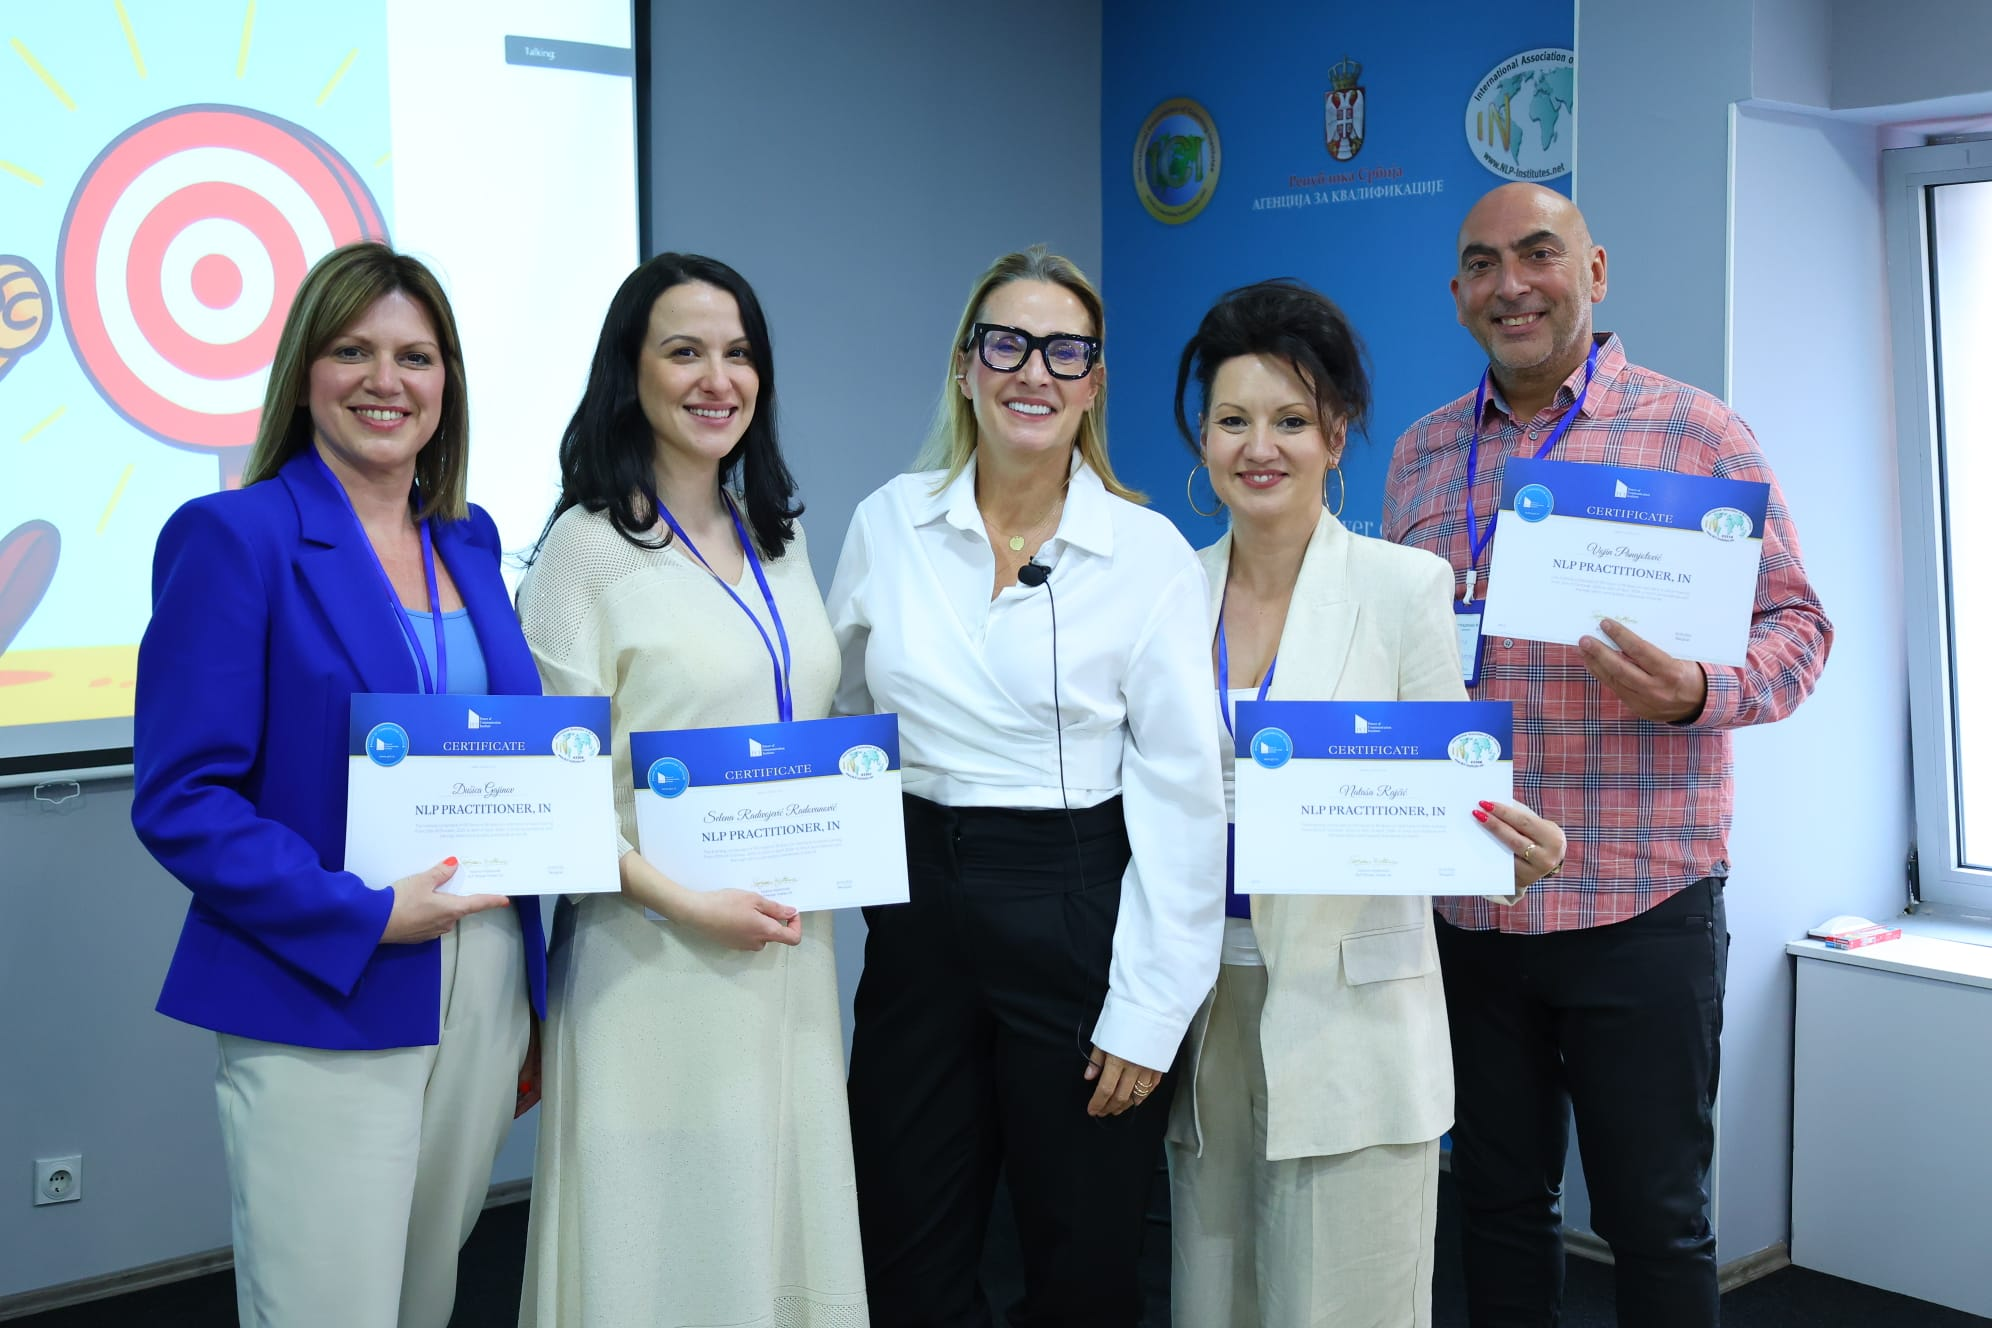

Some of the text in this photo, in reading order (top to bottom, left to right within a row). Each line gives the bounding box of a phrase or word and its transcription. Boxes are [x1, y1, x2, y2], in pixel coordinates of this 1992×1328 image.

[1474, 59, 1519, 102] International
[1521, 50, 1567, 65] Association
[1477, 93, 1511, 152] IN
[1483, 151, 1566, 178] www.NLP-Institutes.net
[1252, 179, 1445, 211] АГЕНЦИЈА ЗА КВАЛИФИКАЦИЈЕ
[1586, 506, 1674, 524] CERTIFICATE
[1552, 558, 1693, 584] NLP PRACTITIONER, IN
[443, 741, 526, 752] CERTIFICATE
[1328, 745, 1419, 756] CERTIFICATE
[725, 764, 812, 781] CERTIFICATE
[415, 803, 552, 816] NLP PRACTITIONER, IN
[1301, 805, 1447, 817] NLP PRACTITIONER, IN
[702, 820, 841, 843] NLP PRACTITIONER, IN
